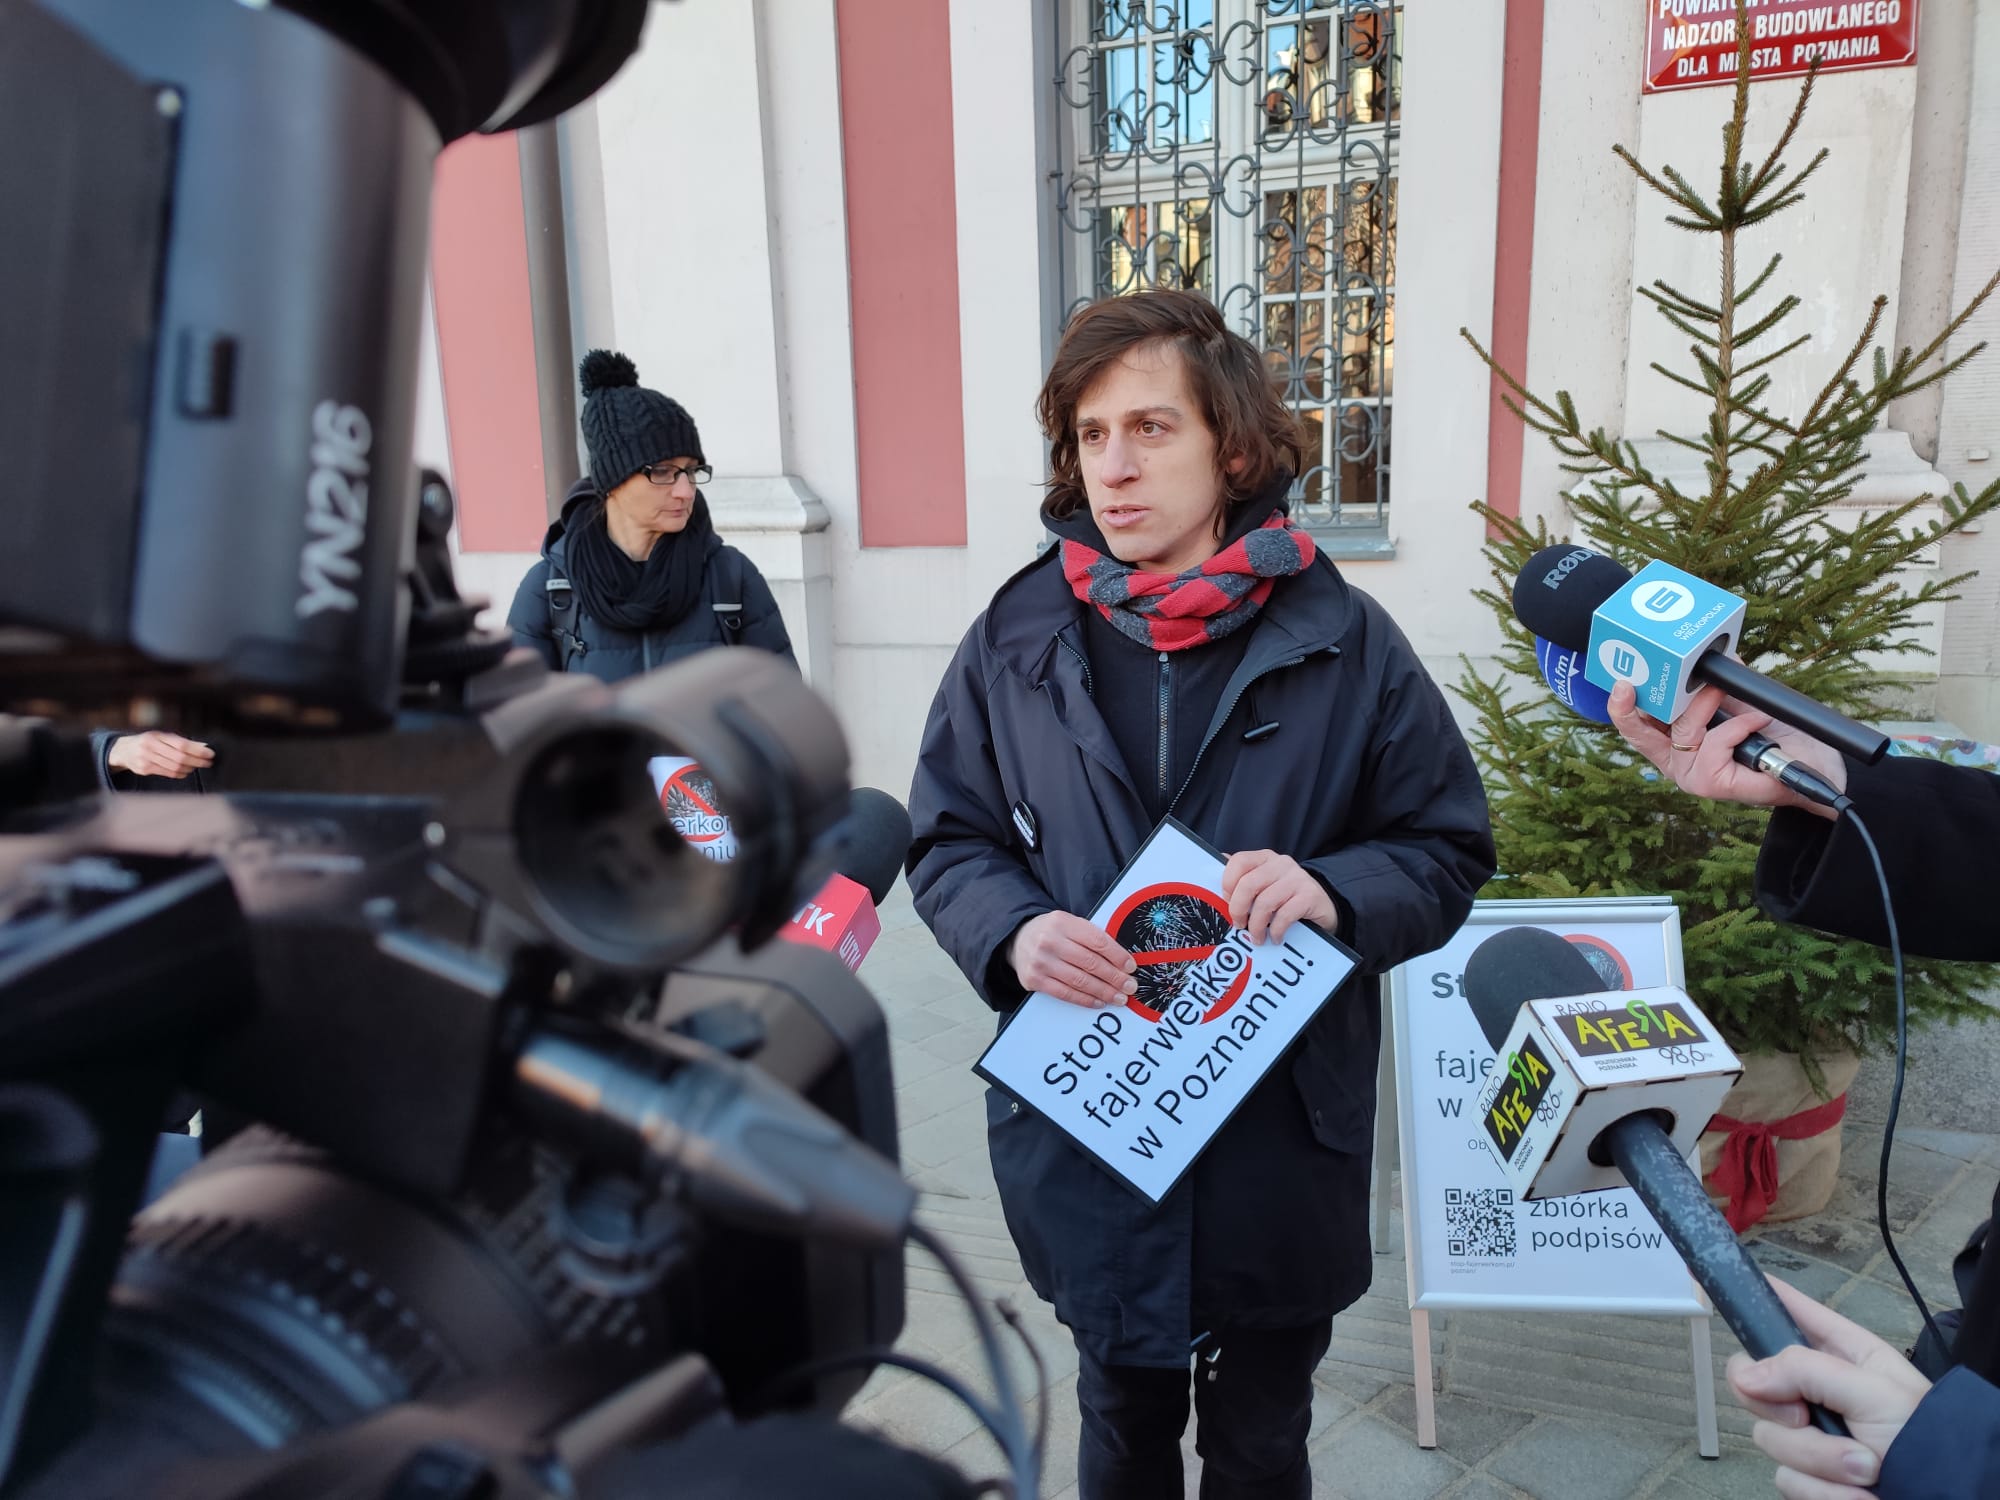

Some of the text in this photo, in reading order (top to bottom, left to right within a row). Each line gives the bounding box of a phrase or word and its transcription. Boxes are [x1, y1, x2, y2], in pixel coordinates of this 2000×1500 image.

[1663, 0, 1900, 50] NADZOR BUDOWLANEGO
[1677, 35, 1880, 78] DLA MISTA POZNANIA
[295, 398, 372, 619] YN216
[1555, 1000, 1608, 1017] RADIO
[1043, 1011, 1122, 1095] Stop
[1128, 942, 1314, 1160] w Poznaniu!
[1658, 1045, 1705, 1067] 98,6
[1480, 1075, 1503, 1117] RADIO
[1530, 1195, 1628, 1218] zbiórka
[1532, 1226, 1662, 1252] podpisów
